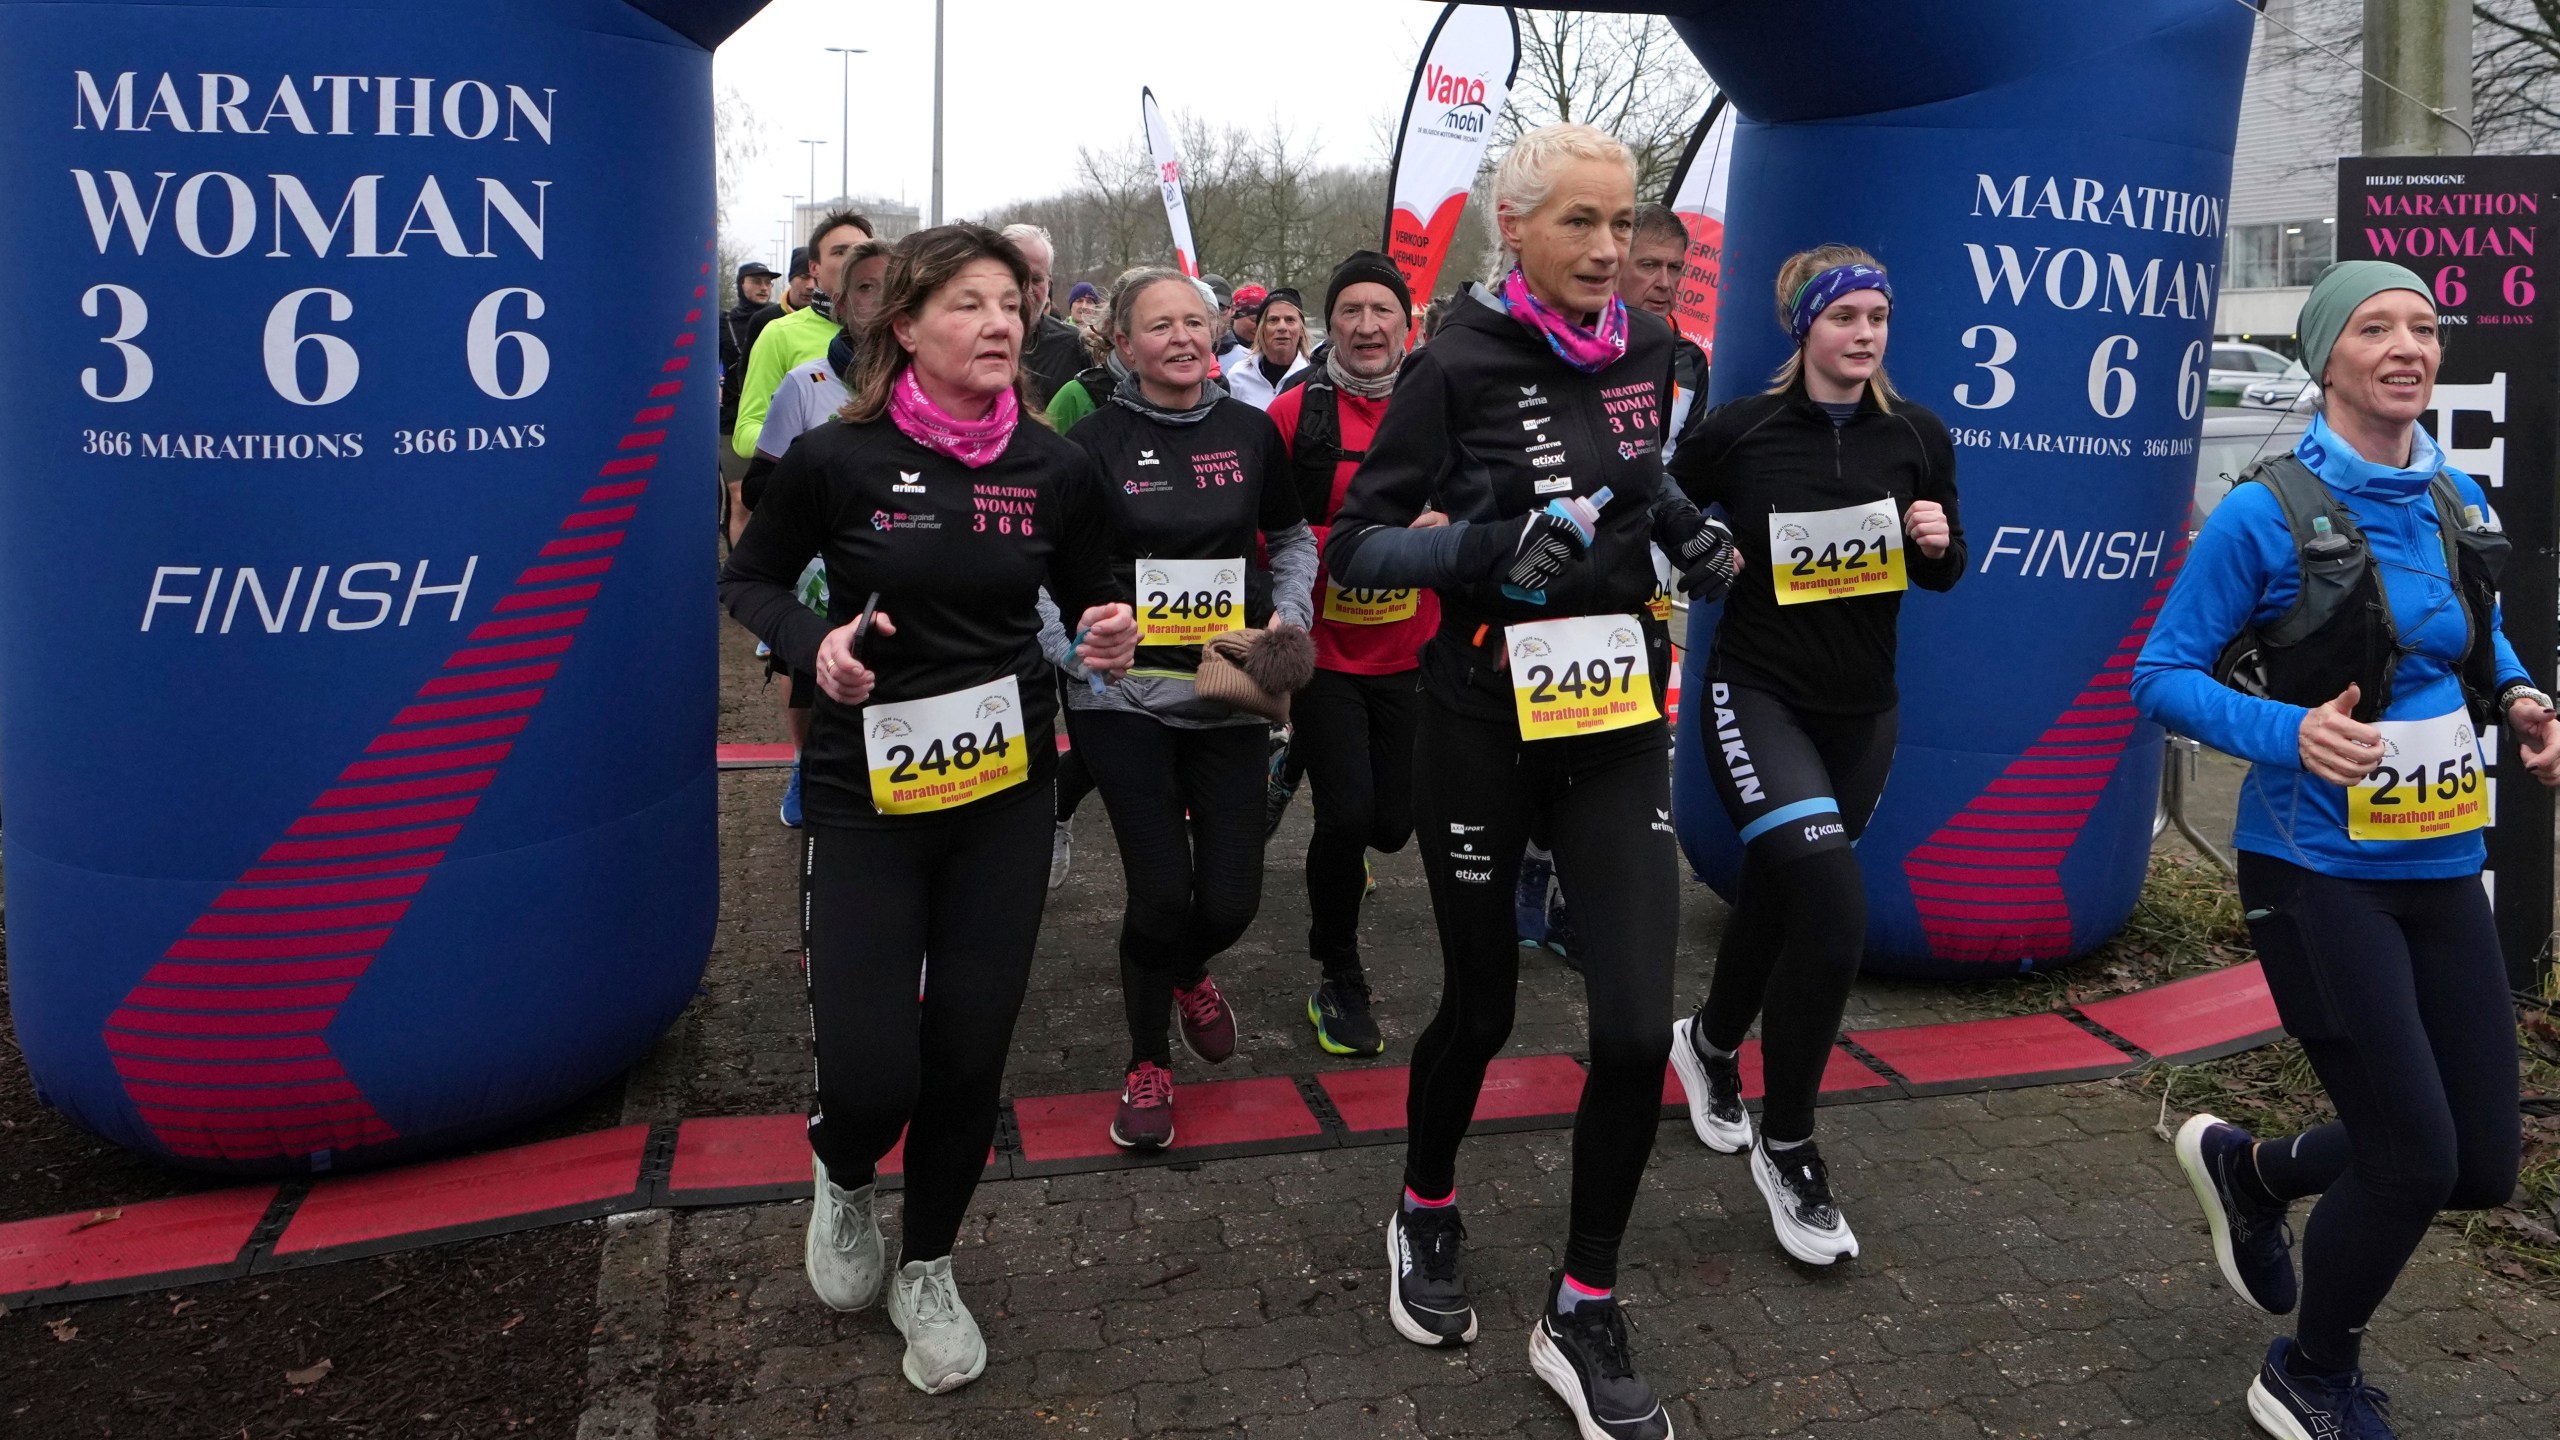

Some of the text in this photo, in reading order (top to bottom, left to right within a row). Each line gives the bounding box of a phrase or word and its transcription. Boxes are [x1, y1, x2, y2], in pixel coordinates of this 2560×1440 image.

[73, 70, 558, 145] MARATHON
[1445, 111, 1484, 133] mobil
[2366, 174, 2465, 185] HILDE DOSOGNE
[69, 168, 553, 260] WOMAN
[1970, 173, 2223, 239] MARATHON
[2366, 193, 2538, 216] MARATHON
[1396, 230, 1429, 248] VERKOOP
[2364, 226, 2536, 257] WOMAN
[1394, 249, 1428, 268] VERHUUR
[1963, 243, 2215, 321] WOMAN
[2477, 315, 2500, 325] 366
[2502, 315, 2533, 325] DAYS
[1600, 381, 1655, 399] MARATHON
[1518, 396, 1548, 409] erima
[1603, 394, 1656, 416] WOMAN
[82, 423, 546, 460] 366 MARATHONS 366 DAYS
[1525, 440, 1562, 453] CHRISTEYNS
[1950, 427, 2193, 457] 366 MARATHONS 366 DAYS
[1191, 449, 1237, 463] MARATHON
[1532, 453, 1561, 466] etixx
[1192, 459, 1240, 474] WOMAN
[892, 483, 926, 494] erima
[973, 484, 1038, 499] MARATHON
[973, 497, 1035, 516] WOMAN
[893, 512, 935, 522] BIG against
[893, 520, 942, 530] breast cancer
[1790, 535, 1888, 576] 2421
[1980, 526, 2165, 580] FINISH
[1790, 570, 1888, 592] Marathon and More
[1828, 586, 1855, 595] Belgium
[140, 555, 479, 634] FINISH
[1148, 590, 1232, 620] 2486
[1336, 603, 1407, 615] Marathon and More
[1147, 624, 1191, 634] Marathon
[1207, 623, 1229, 633] More
[1527, 656, 1635, 704] 2497
[1532, 700, 1637, 724] Marathon and More
[1576, 719, 1604, 729] Belgium
[886, 721, 1010, 784] 2484
[1712, 683, 1766, 804] DAIKIN
[892, 765, 1009, 803] Marathon and More
[2369, 753, 2476, 805] 2155
[941, 790, 973, 805] Belgium
[2370, 800, 2478, 824] Marathon and More
[2420, 822, 2450, 833] Belgium
[1450, 852, 1491, 861] CHRISTEYNS
[1455, 868, 1488, 881] etixx
